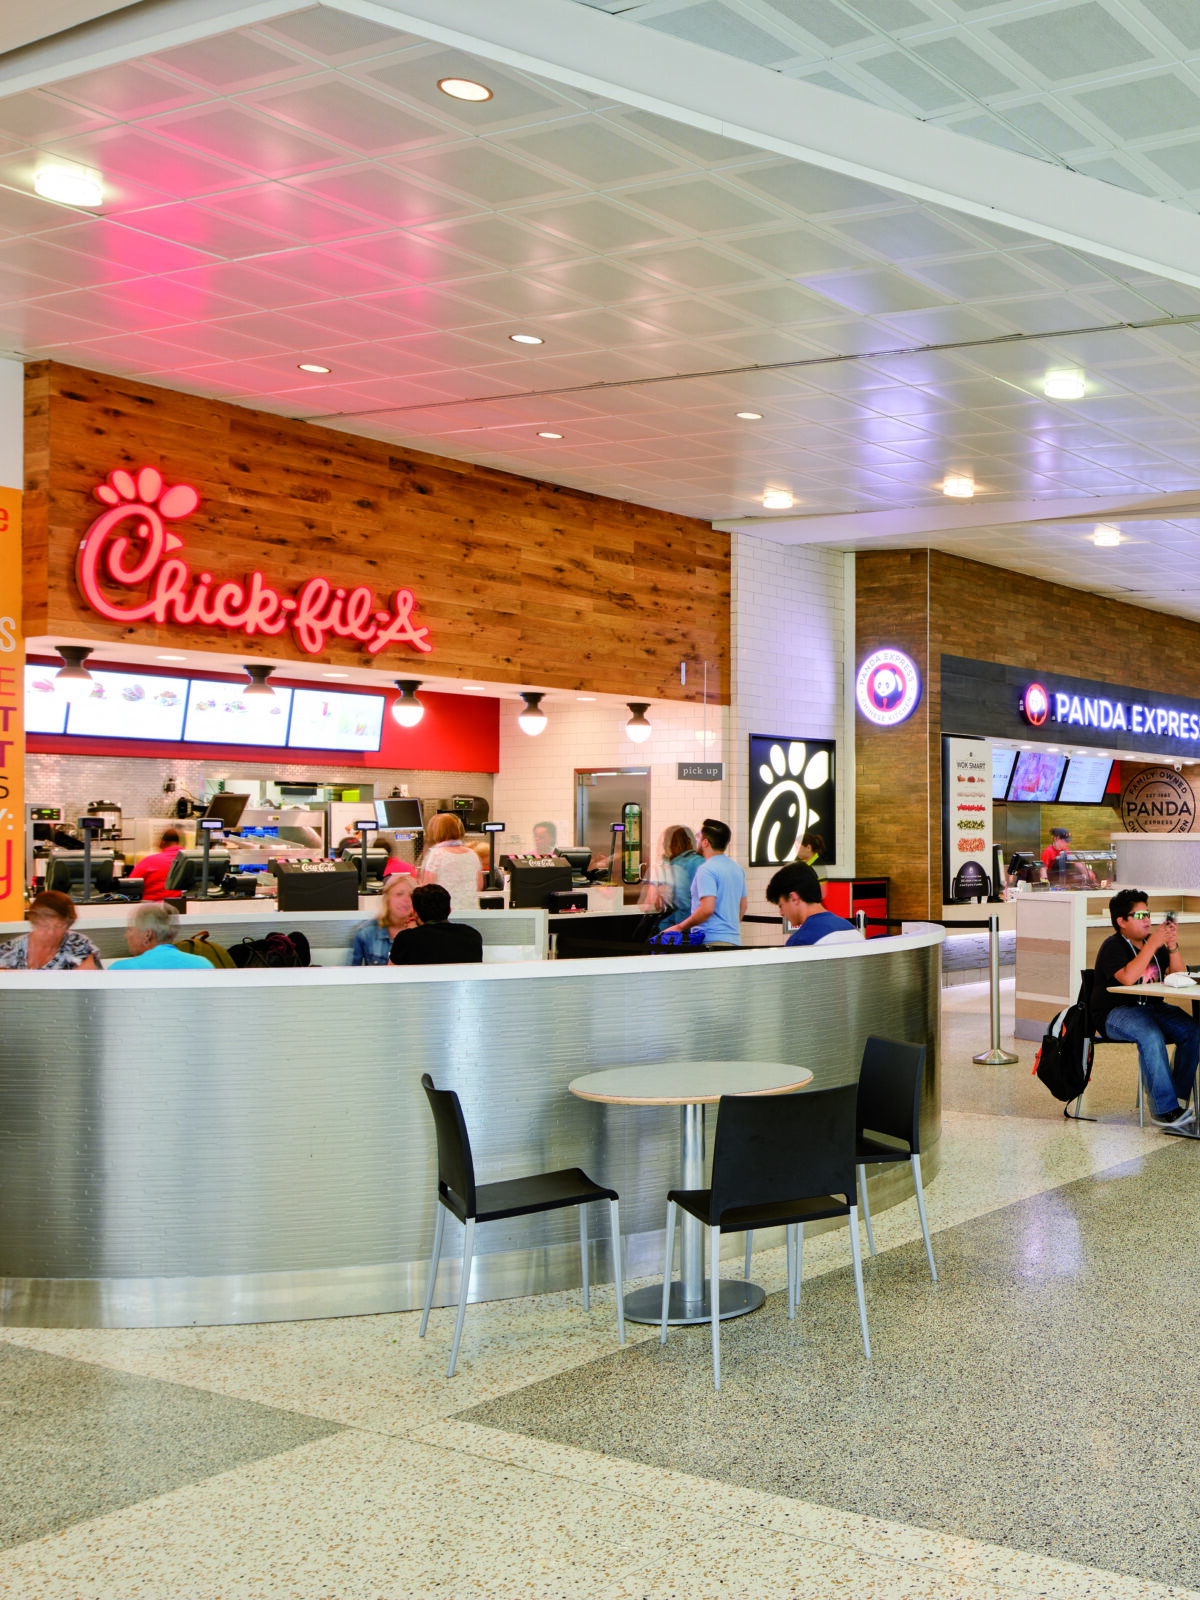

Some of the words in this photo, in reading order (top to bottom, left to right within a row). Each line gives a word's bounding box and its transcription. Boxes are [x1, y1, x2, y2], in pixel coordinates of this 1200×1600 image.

[80, 466, 433, 654] Chick-fil-A
[859, 655, 881, 685] PANDA
[883, 652, 915, 682] EXPRESS
[1055, 693, 1127, 731] PANDA
[683, 767, 703, 776] pick
[1129, 772, 1155, 795] FAMILY
[1159, 771, 1188, 794] OWNED
[1126, 801, 1192, 817] PANDA
